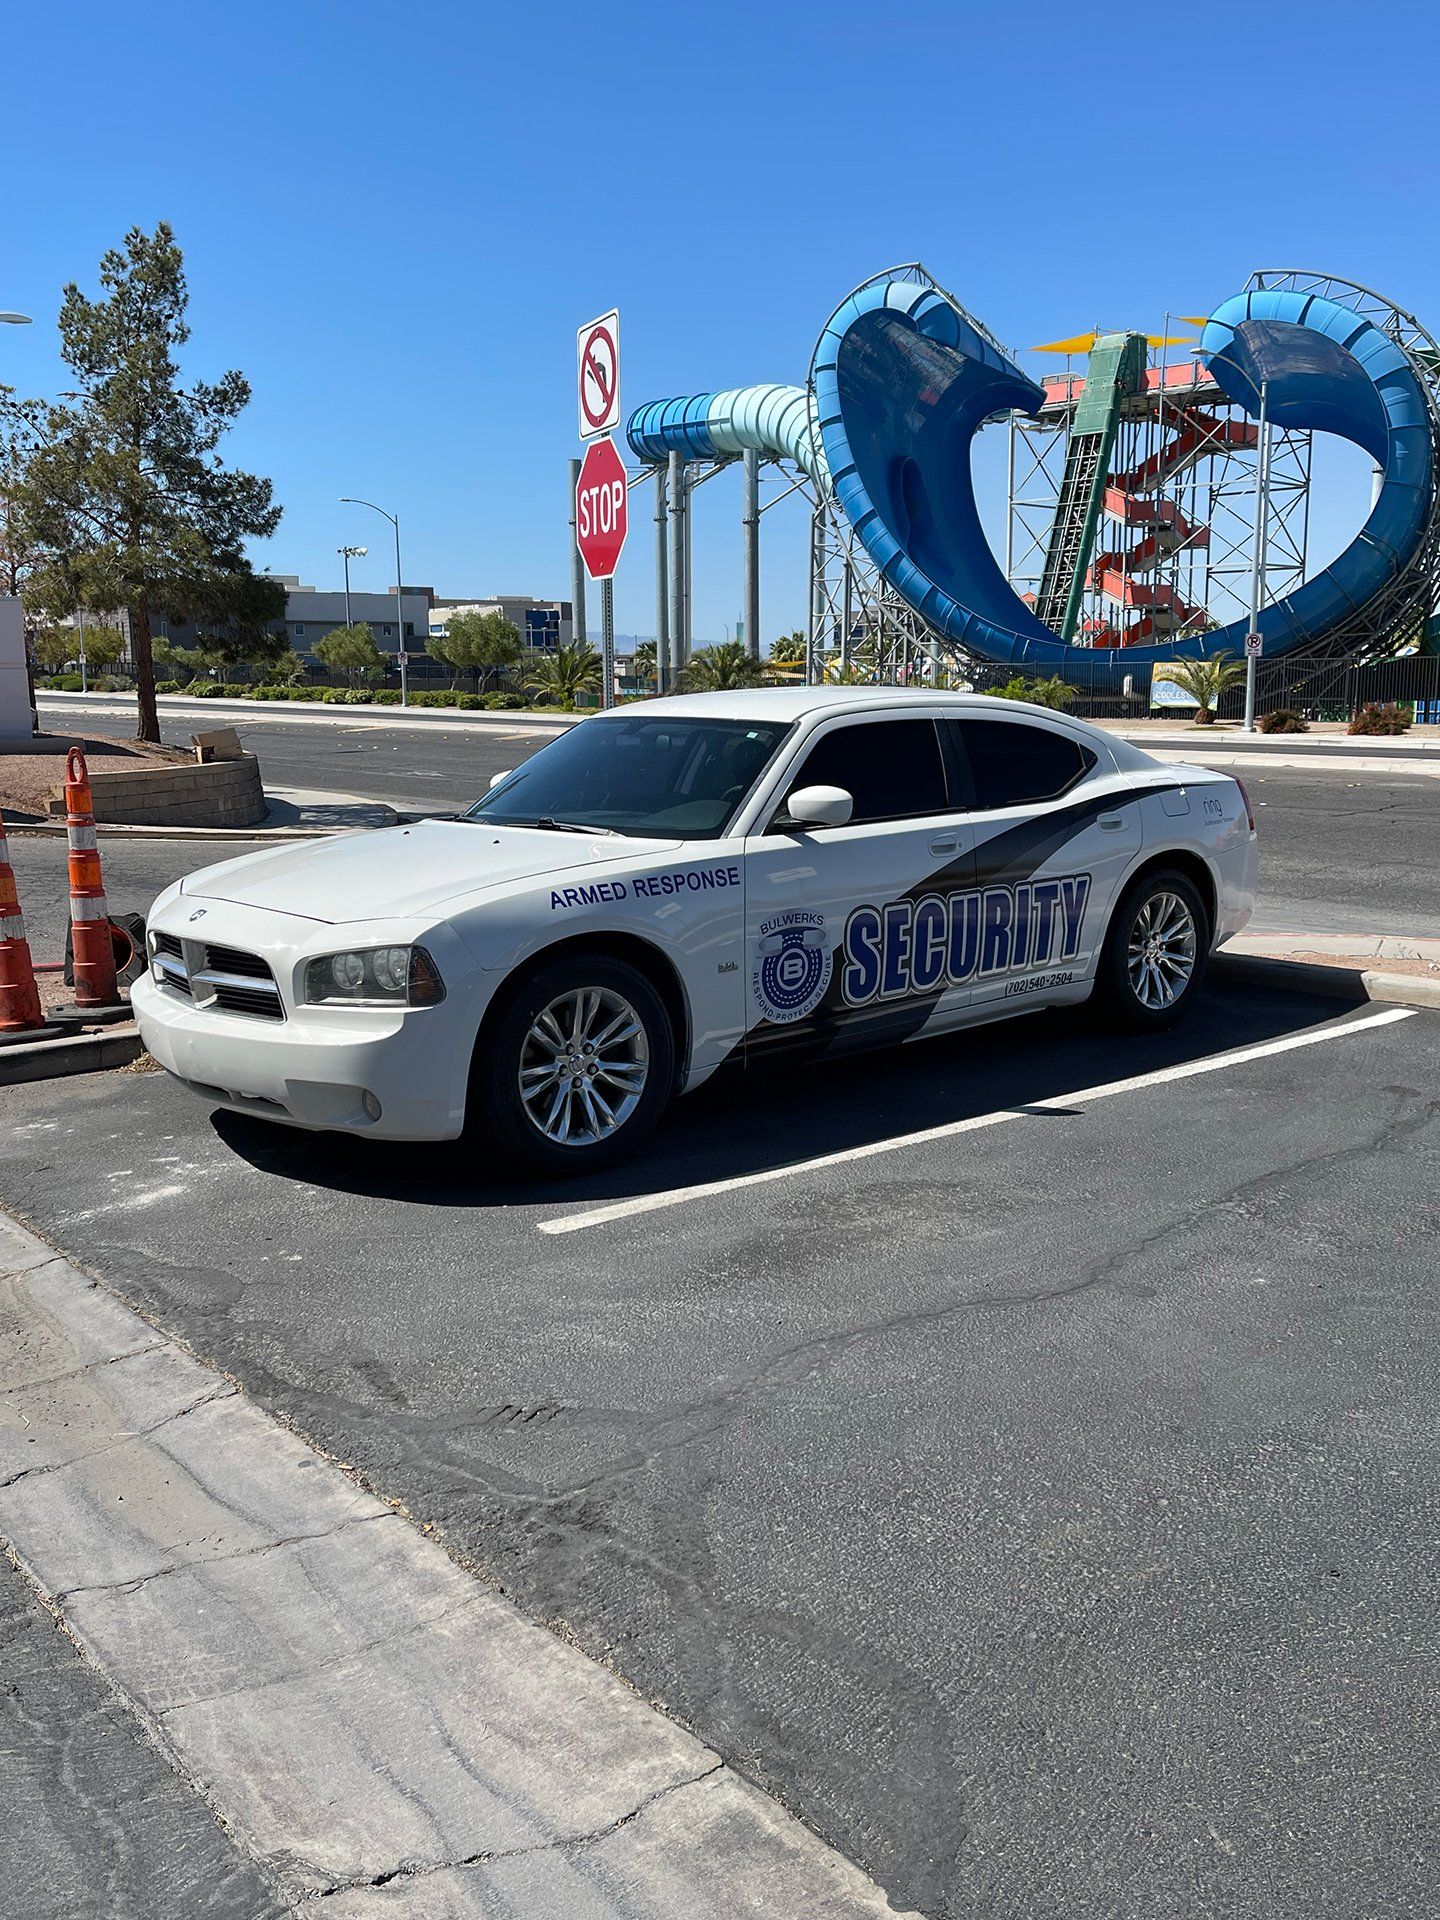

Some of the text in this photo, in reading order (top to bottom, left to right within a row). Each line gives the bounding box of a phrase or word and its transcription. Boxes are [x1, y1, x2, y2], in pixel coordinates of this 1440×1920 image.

[580, 480, 624, 538] STOP
[550, 867, 741, 910] ARMED RESPONSE
[760, 913, 824, 935] BULWERKS
[842, 873, 1092, 1007] SECURITY
[783, 959, 804, 980] B
